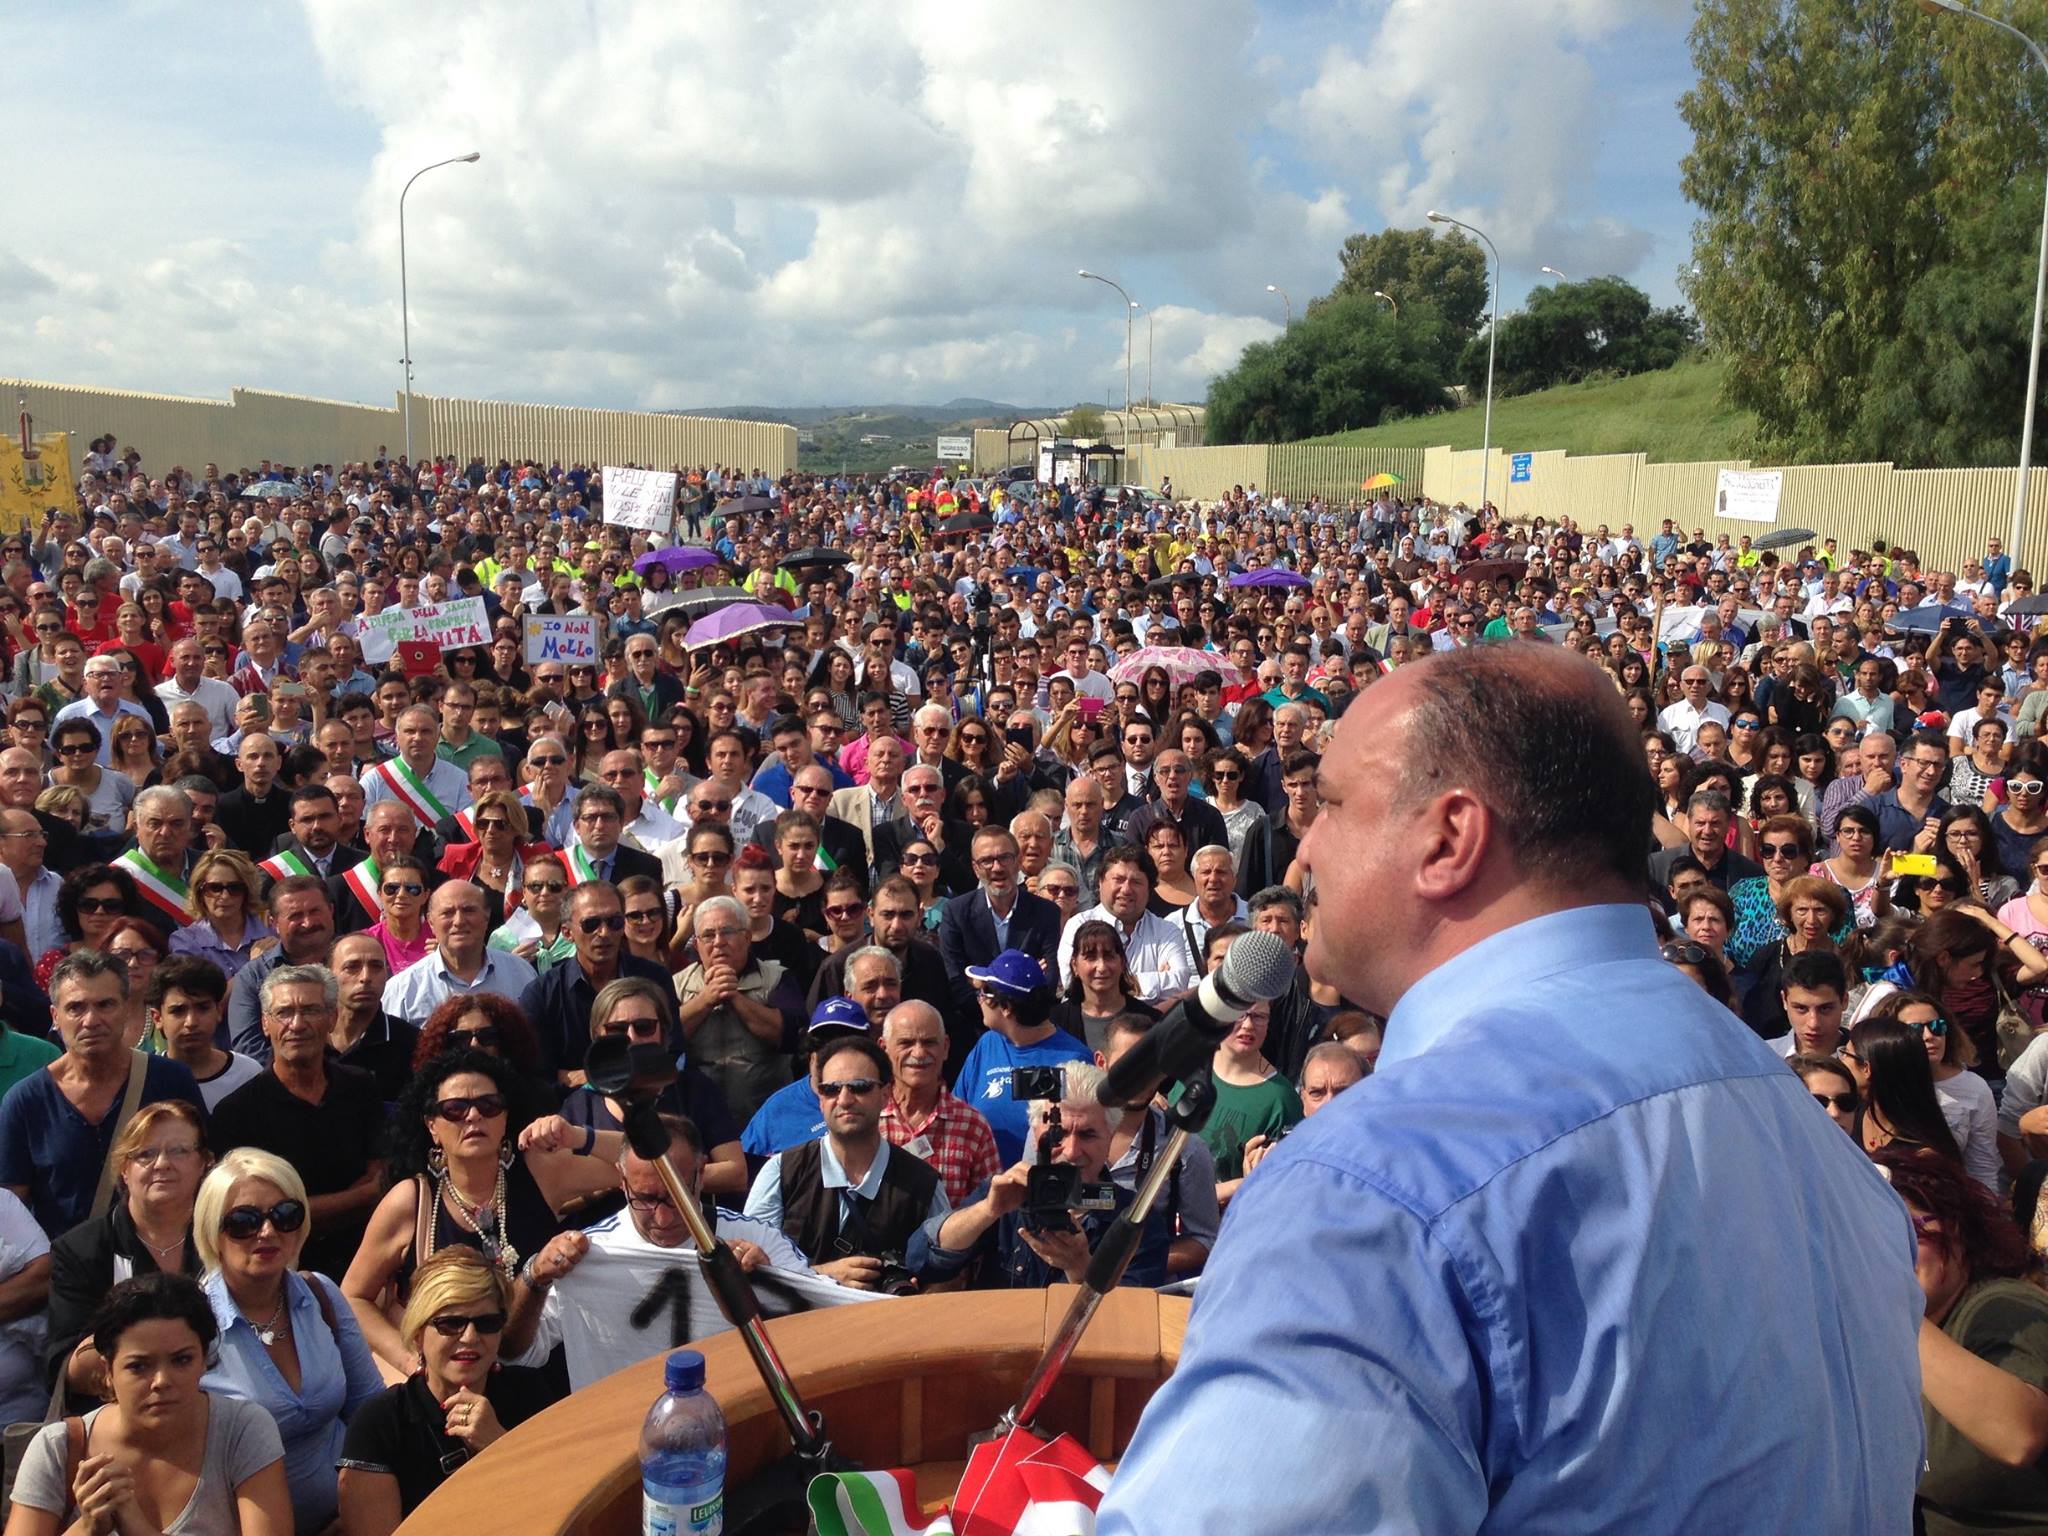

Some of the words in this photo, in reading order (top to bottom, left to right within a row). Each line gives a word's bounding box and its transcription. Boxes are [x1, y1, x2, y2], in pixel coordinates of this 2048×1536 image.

[412, 606, 439, 619] DELLA
[414, 624, 429, 638] LA
[543, 621, 561, 631] IO
